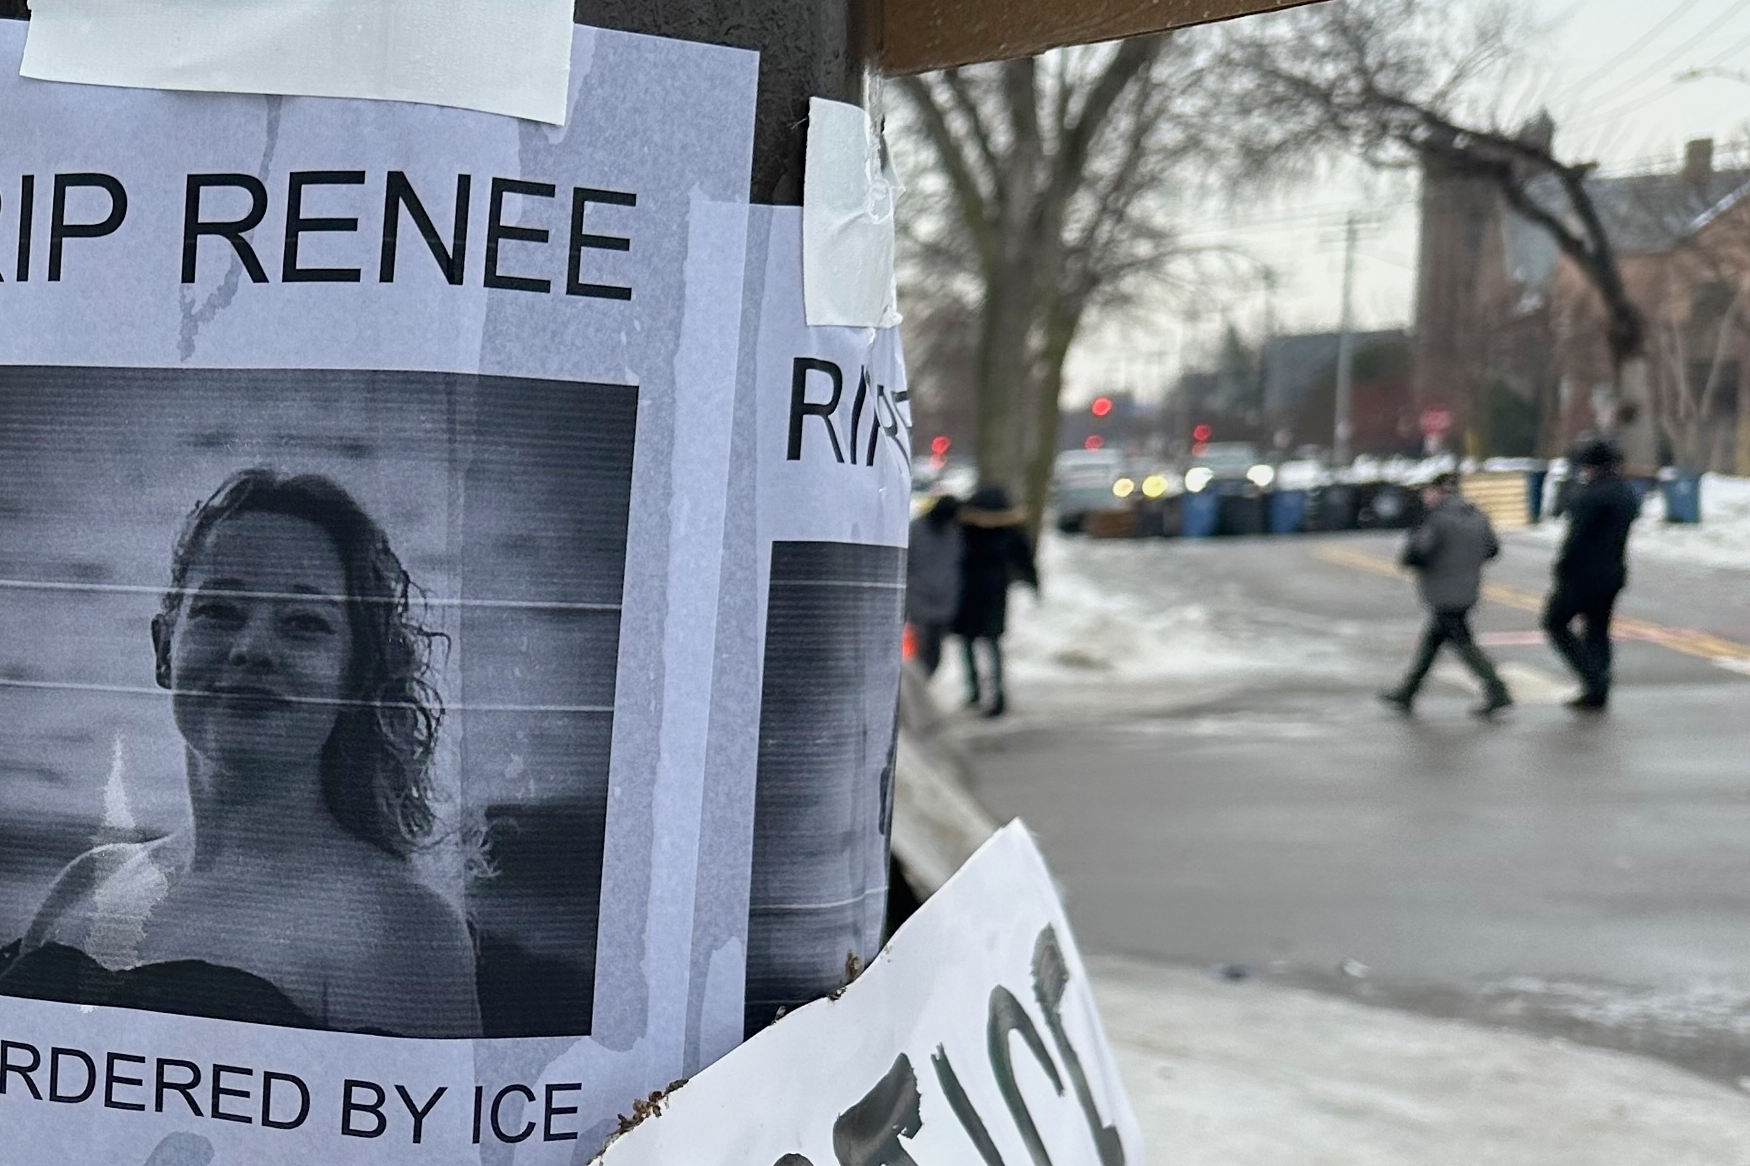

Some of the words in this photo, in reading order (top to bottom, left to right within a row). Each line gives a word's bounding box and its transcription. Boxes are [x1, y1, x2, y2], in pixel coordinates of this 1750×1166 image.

[180, 169, 638, 302] RENEE
[340, 1078, 448, 1146] BY
[471, 1082, 583, 1144] ICE
